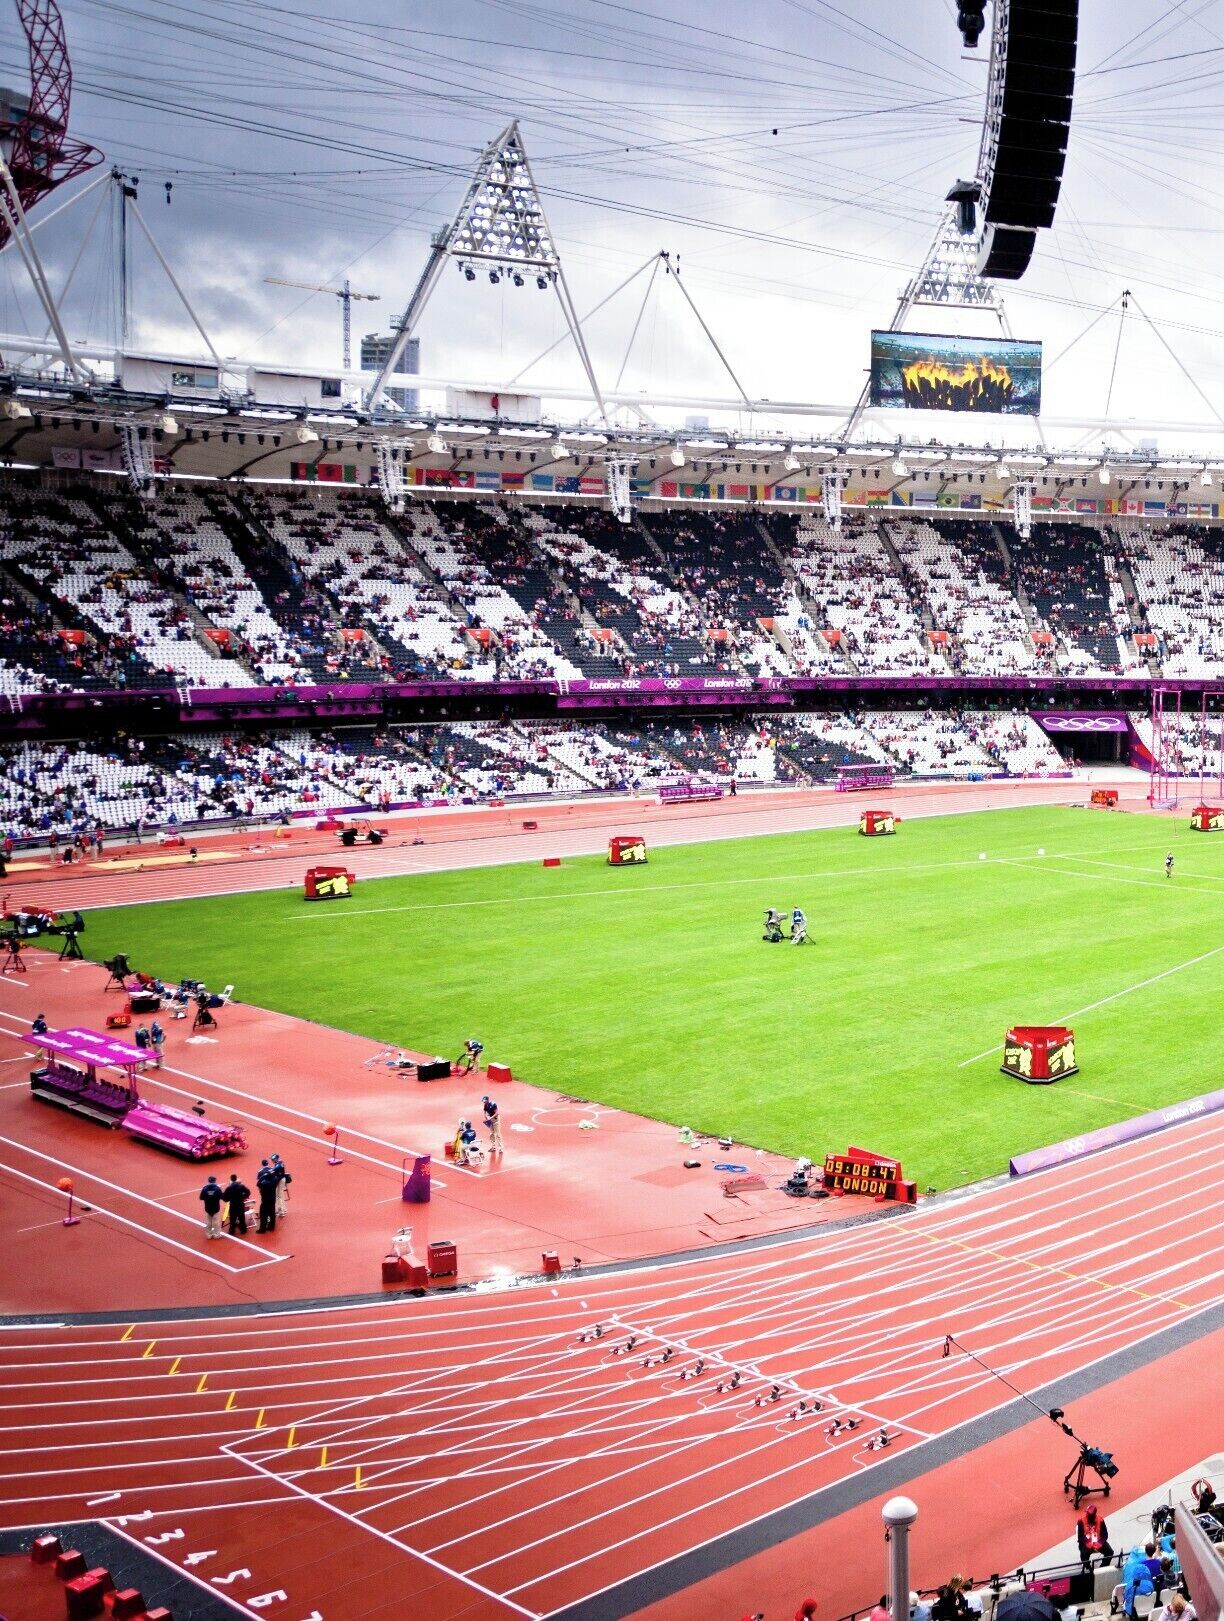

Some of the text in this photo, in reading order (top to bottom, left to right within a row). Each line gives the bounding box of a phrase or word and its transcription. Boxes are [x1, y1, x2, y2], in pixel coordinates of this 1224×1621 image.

[589, 680, 641, 690] London 2012
[704, 678, 734, 688] London
[1162, 1099, 1206, 1122] London 2012
[826, 1160, 897, 1180] 09:08:47
[834, 1176, 887, 1194] LONDON
[86, 1492, 122, 1506] 1
[118, 1509, 154, 1526] 2
[144, 1528, 186, 1545] 3
[182, 1549, 218, 1565] 4
[211, 1567, 252, 1584] 5
[246, 1589, 288, 1607] 6
